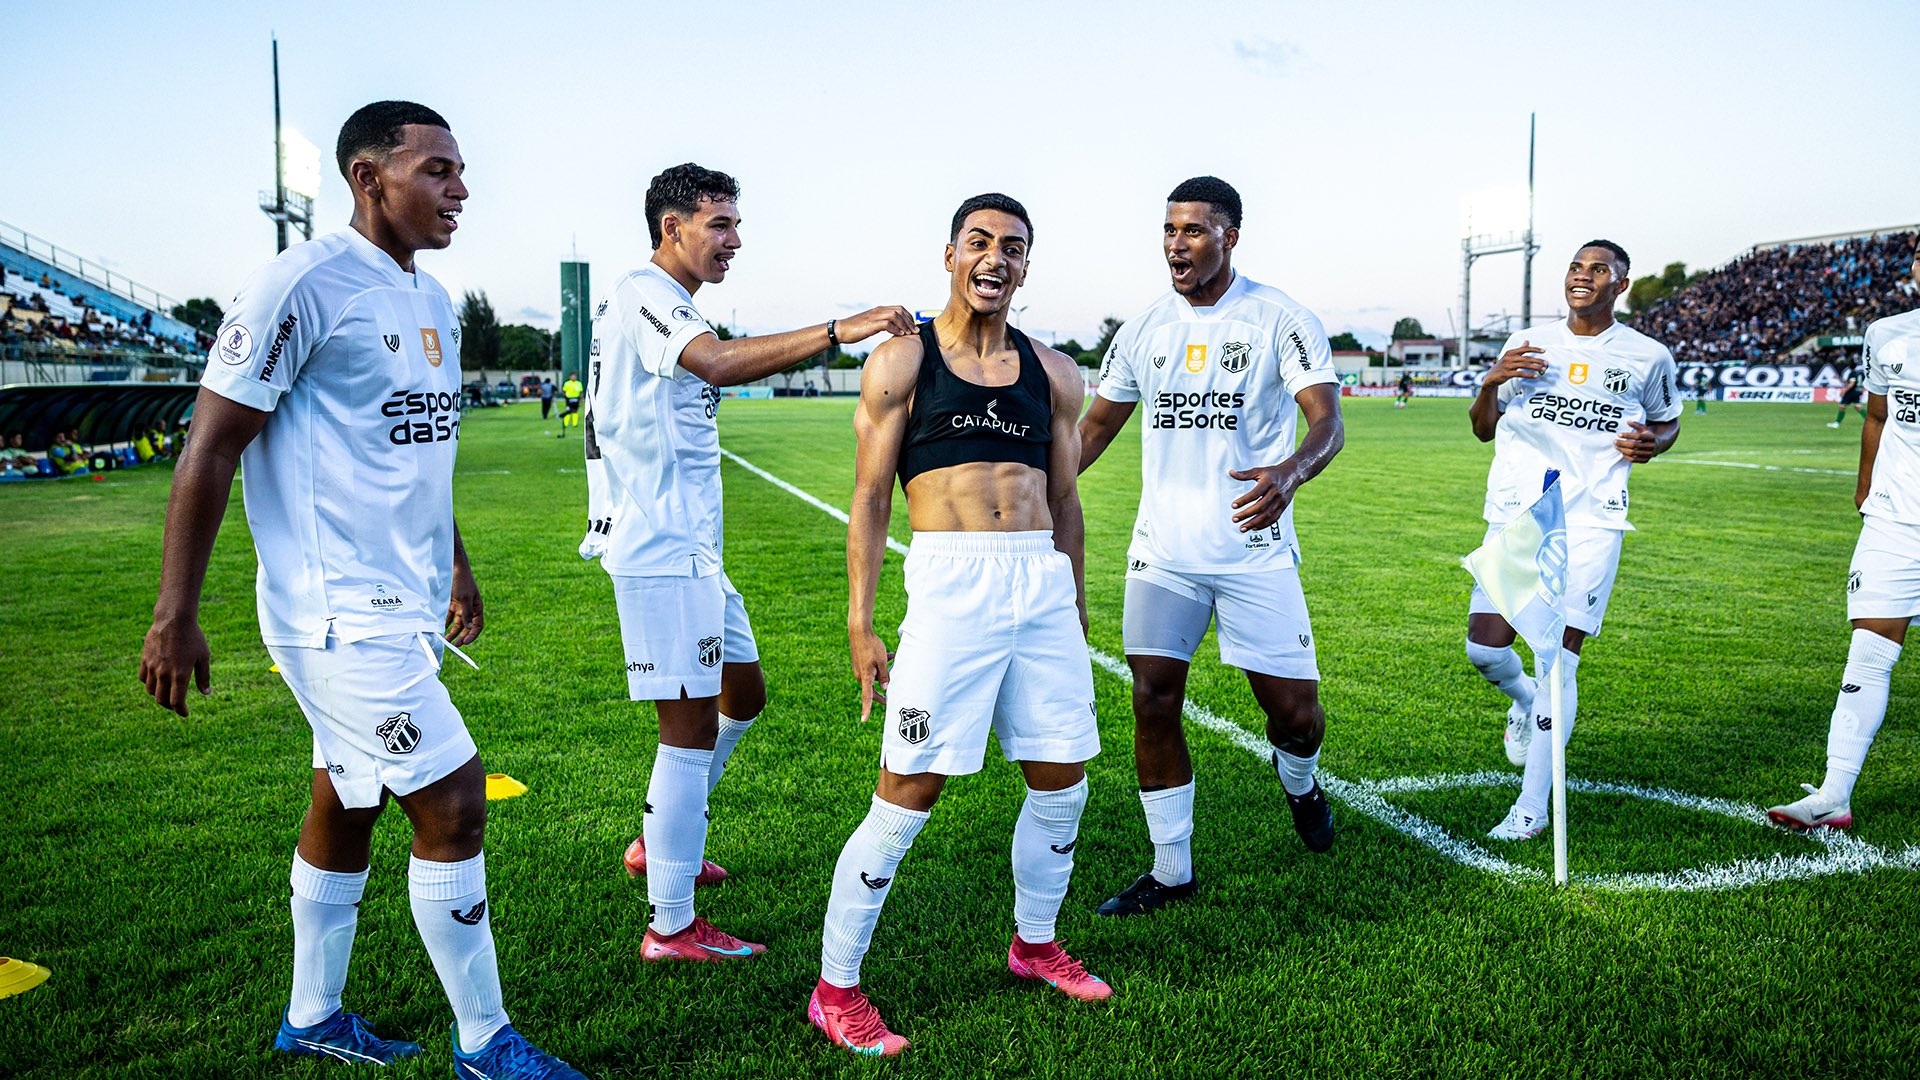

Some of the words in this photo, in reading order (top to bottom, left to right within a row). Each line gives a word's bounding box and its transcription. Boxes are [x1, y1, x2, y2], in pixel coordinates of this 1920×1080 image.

[1529, 392, 1625, 419] Esportes
[951, 414, 1031, 437] CATAPULT
[1178, 410, 1238, 430] Sorte
[1557, 411, 1619, 433] Sorte
[370, 595, 402, 605] CEARÁ
